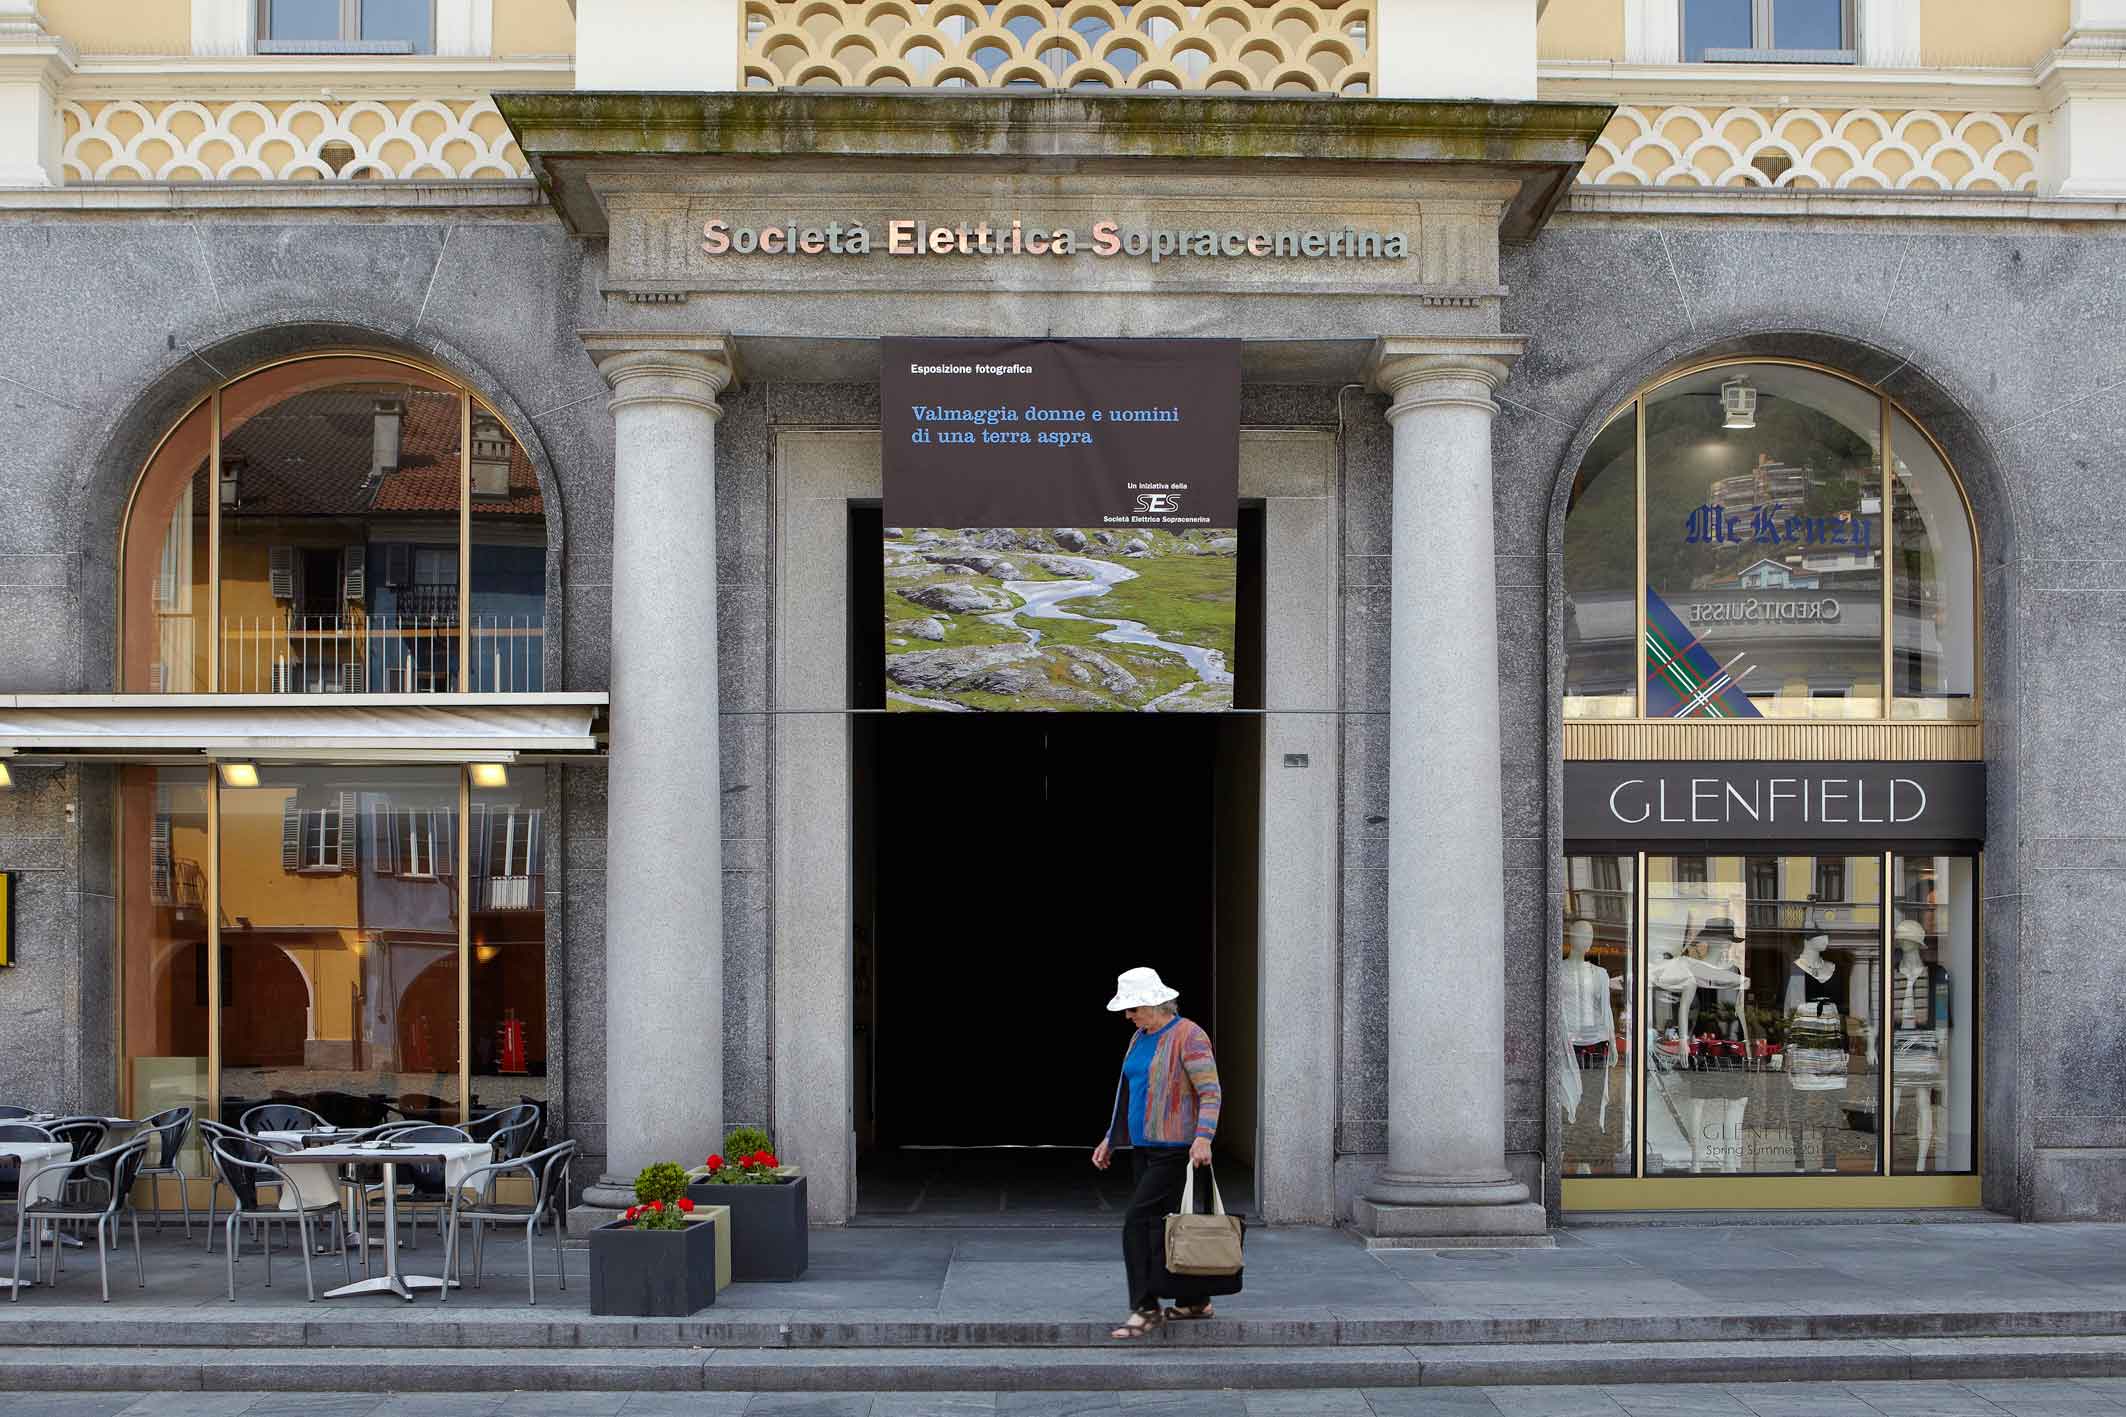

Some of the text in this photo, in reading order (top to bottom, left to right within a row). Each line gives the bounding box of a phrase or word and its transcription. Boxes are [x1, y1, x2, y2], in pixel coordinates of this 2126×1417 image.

[702, 219, 1408, 264] Società Elettrica Sopracenerina
[911, 364, 1033, 376] Esposizione fotografica
[911, 405, 1180, 425] Valmaggia donne e uomini
[911, 428, 1093, 447] di una terra aspra
[1127, 482, 1188, 490] Un iniziativa della
[1133, 494, 1181, 513] SES
[1103, 515, 1130, 523] Società
[1162, 516, 1211, 524] Sopracenerina
[1750, 503, 1872, 558] Kenzy
[1609, 778, 1927, 823] GLENFIELD
[1706, 1144, 1743, 1157] Spring
[1747, 1144, 1796, 1156] Summer
